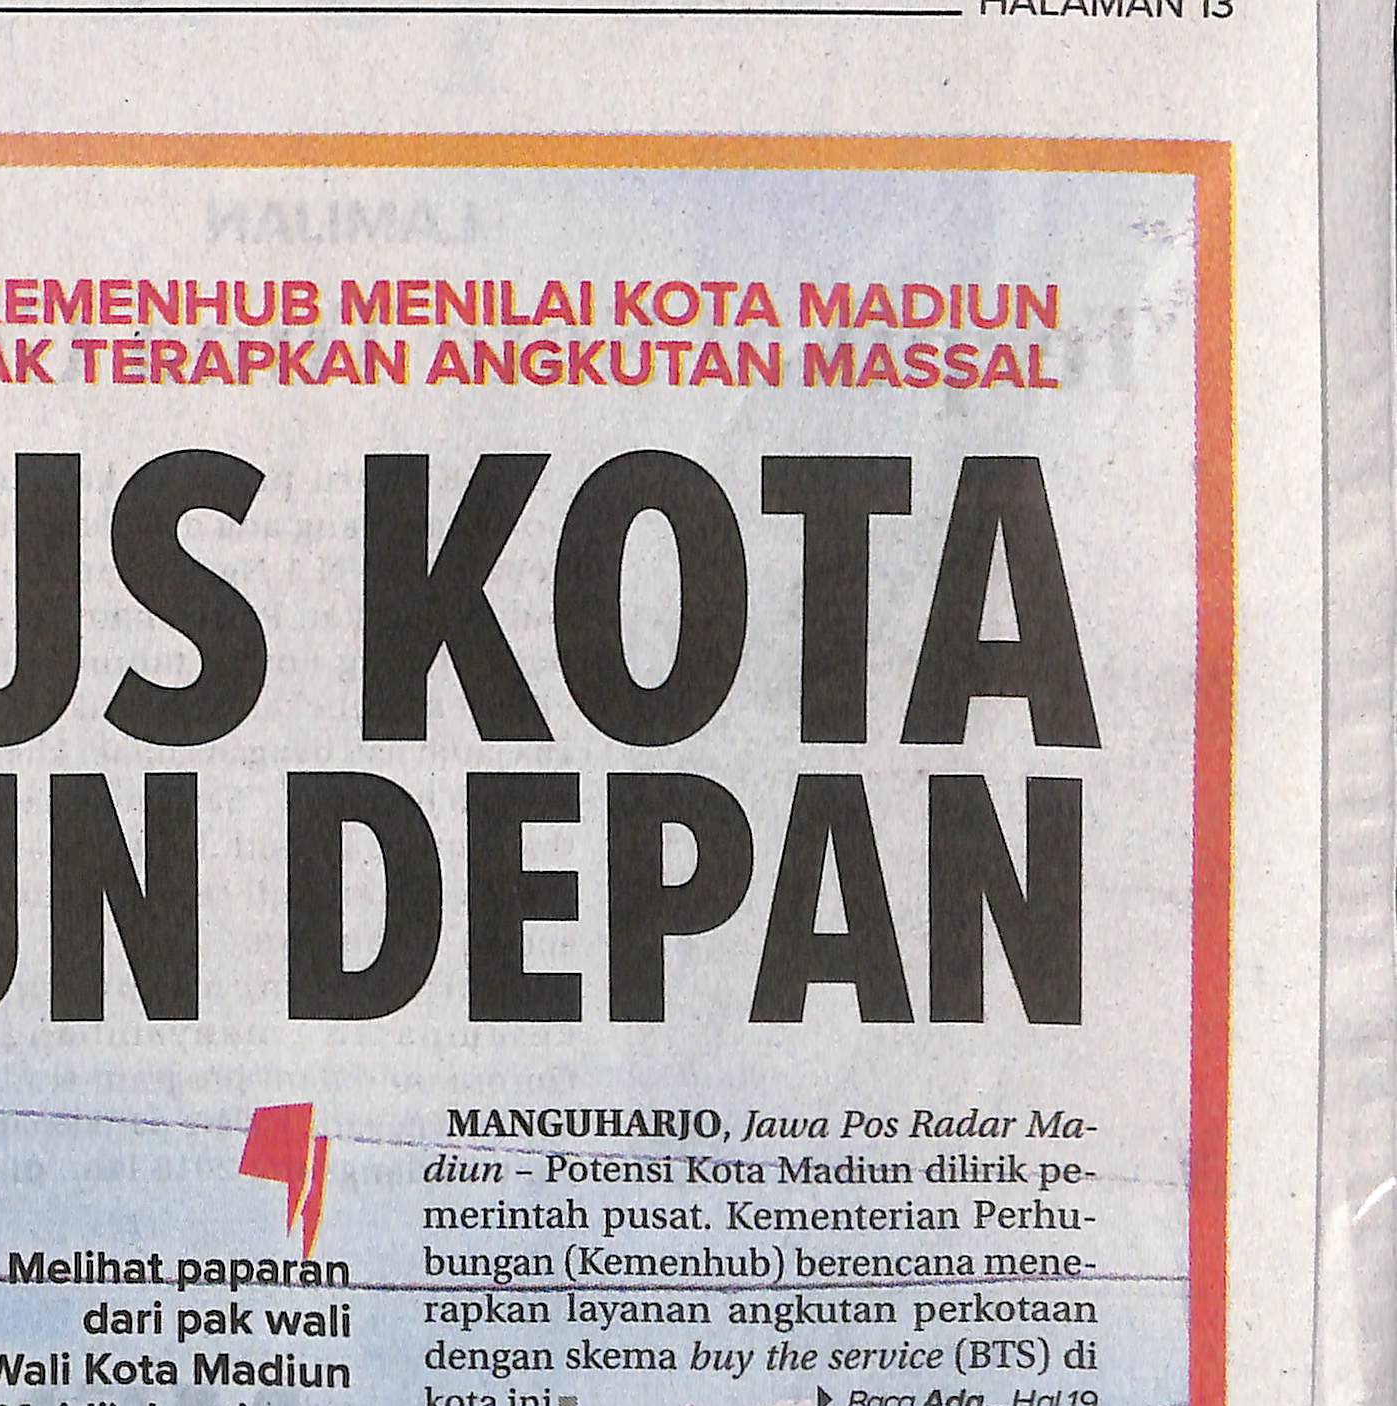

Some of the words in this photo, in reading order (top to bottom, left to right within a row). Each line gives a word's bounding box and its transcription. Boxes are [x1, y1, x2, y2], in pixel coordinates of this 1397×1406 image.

[980, 0, 1183, 18] HALAMAN
[1203, 0, 1234, 19] 13
[341, 279, 592, 326] MENILAI
[614, 280, 779, 327] KOTA
[800, 282, 1058, 330] MADIUN
[71, 339, 406, 385] TERAPKAN
[426, 339, 780, 387] ANGKUTAN
[804, 343, 1058, 389] MASSAL
[361, 449, 1102, 749] KOTA
[286, 771, 1083, 1026] DEPAN
[446, 1108, 730, 1143] MANGUHARJO,
[740, 1110, 828, 1142] Jawa
[840, 1110, 899, 1139] Pos
[908, 1108, 1017, 1138] Radar
[1025, 1110, 1098, 1139] Ma-
[423, 1153, 502, 1183] diun
[545, 1154, 674, 1183] Potensi
[686, 1156, 766, 1184] Kota
[777, 1155, 913, 1184] Madiun
[925, 1153, 1028, 1183] dilirik
[1039, 1163, 1096, 1192] pe-
[423, 1198, 589, 1230] merintah
[603, 1204, 711, 1238] pusat.
[726, 1200, 960, 1231] Kementerian
[974, 1198, 1096, 1230] Perhu-
[8, 1249, 165, 1285] Melihat
[176, 1258, 349, 1293] paparan
[423, 1245, 555, 1283] bungan
[564, 1243, 784, 1284] (Kemenhub)
[795, 1244, 975, 1277] berencana
[984, 1254, 1096, 1277] mene-
[83, 1300, 162, 1335] dari
[177, 1301, 253, 1344] pak
[264, 1303, 350, 1338] wali
[423, 1293, 551, 1332] rapkan
[567, 1291, 712, 1332] layanan
[727, 1290, 898, 1333] angkutan
[913, 1290, 1098, 1332] perkotaan
[85, 1352, 178, 1386] Kota
[194, 1353, 350, 1389] Madiun
[425, 1339, 555, 1379] dengan
[565, 1338, 677, 1370] skema
[690, 1340, 754, 1379] buy
[766, 1340, 818, 1371] the
[828, 1341, 944, 1370] service
[955, 1336, 1049, 1376] (BTS)
[1063, 1339, 1098, 1370] di
